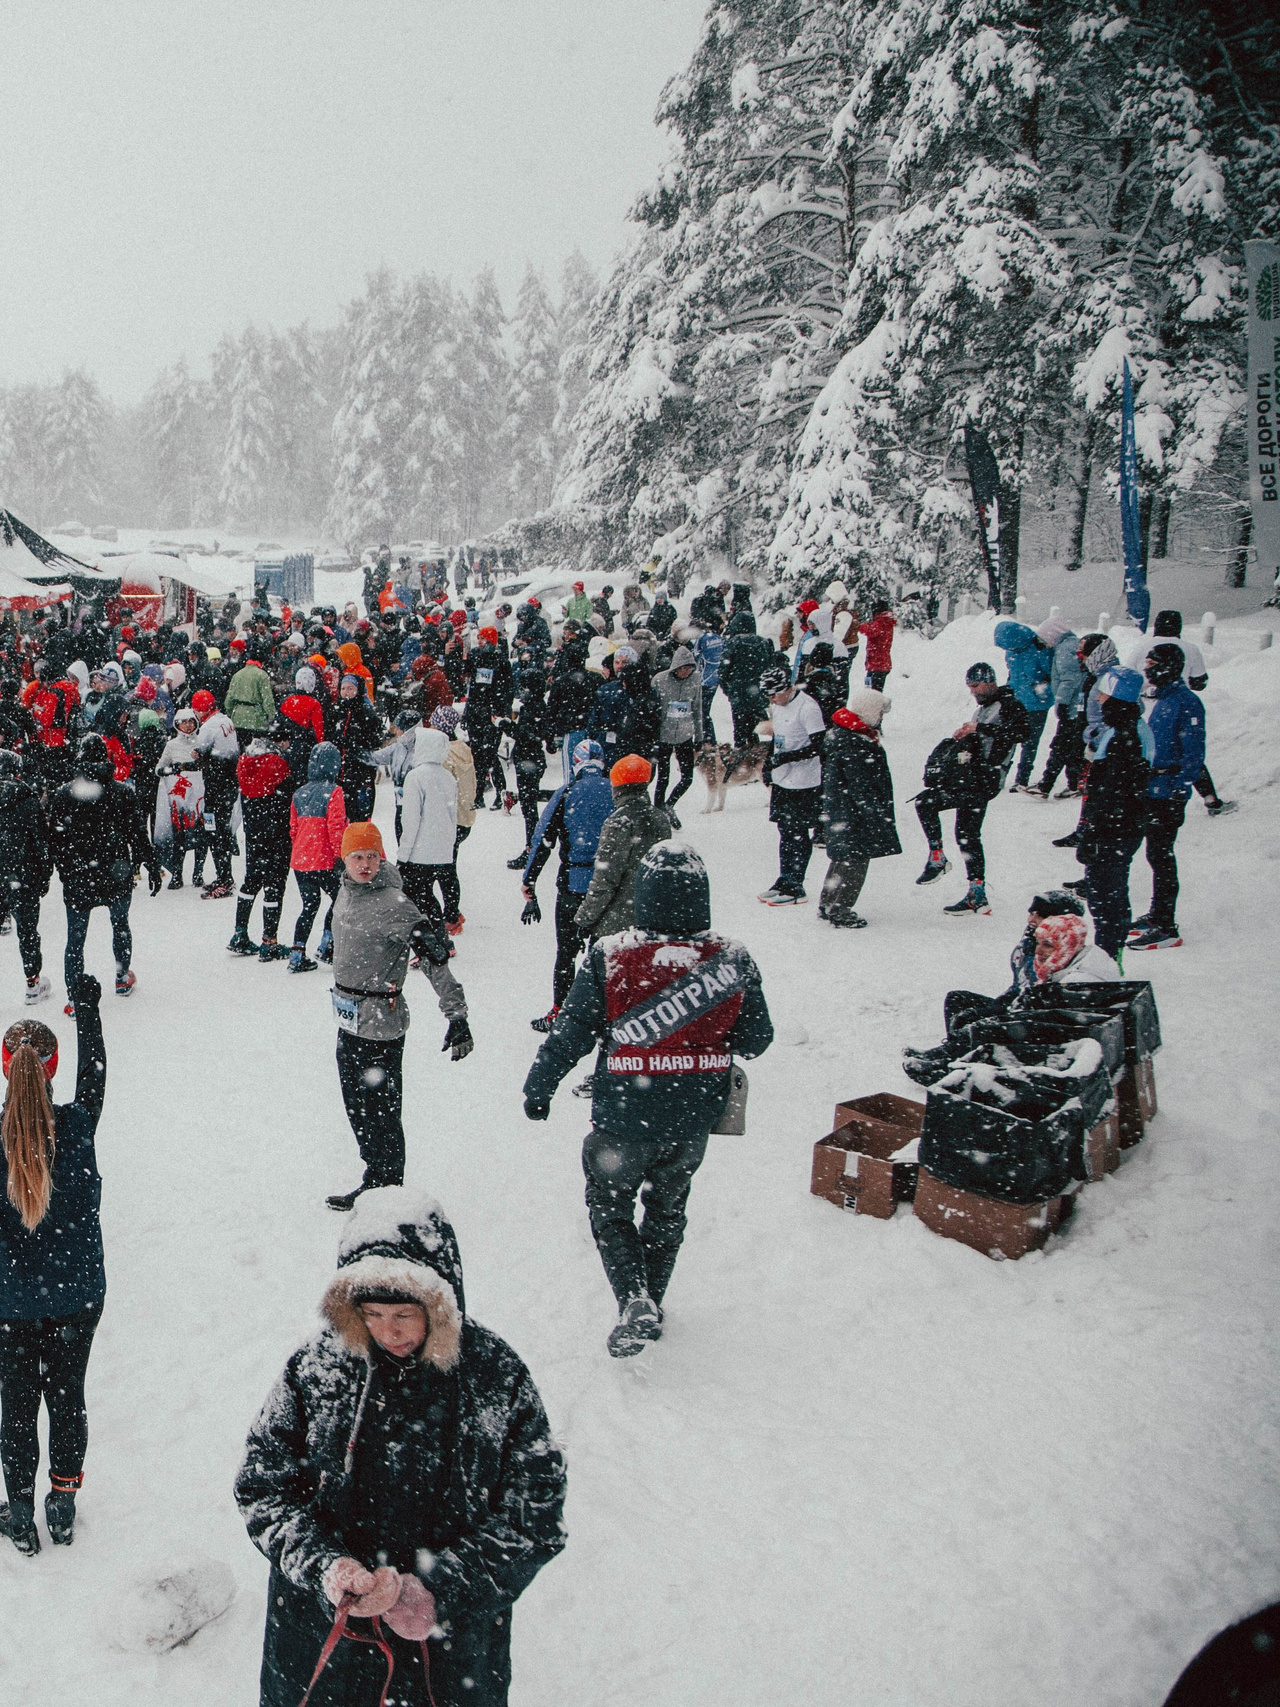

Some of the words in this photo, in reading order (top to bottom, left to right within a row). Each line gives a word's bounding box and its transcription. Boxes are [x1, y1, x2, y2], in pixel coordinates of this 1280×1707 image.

[1257, 373, 1277, 457] ДОРОГИ
[1258, 463, 1278, 502] ВСЕ
[337, 1008, 355, 1020] 939
[611, 961, 740, 1047] ФОТОГРАФ
[607, 1055, 644, 1071] HARD
[649, 1054, 695, 1070] HARD
[699, 1053, 732, 1070] HARD
